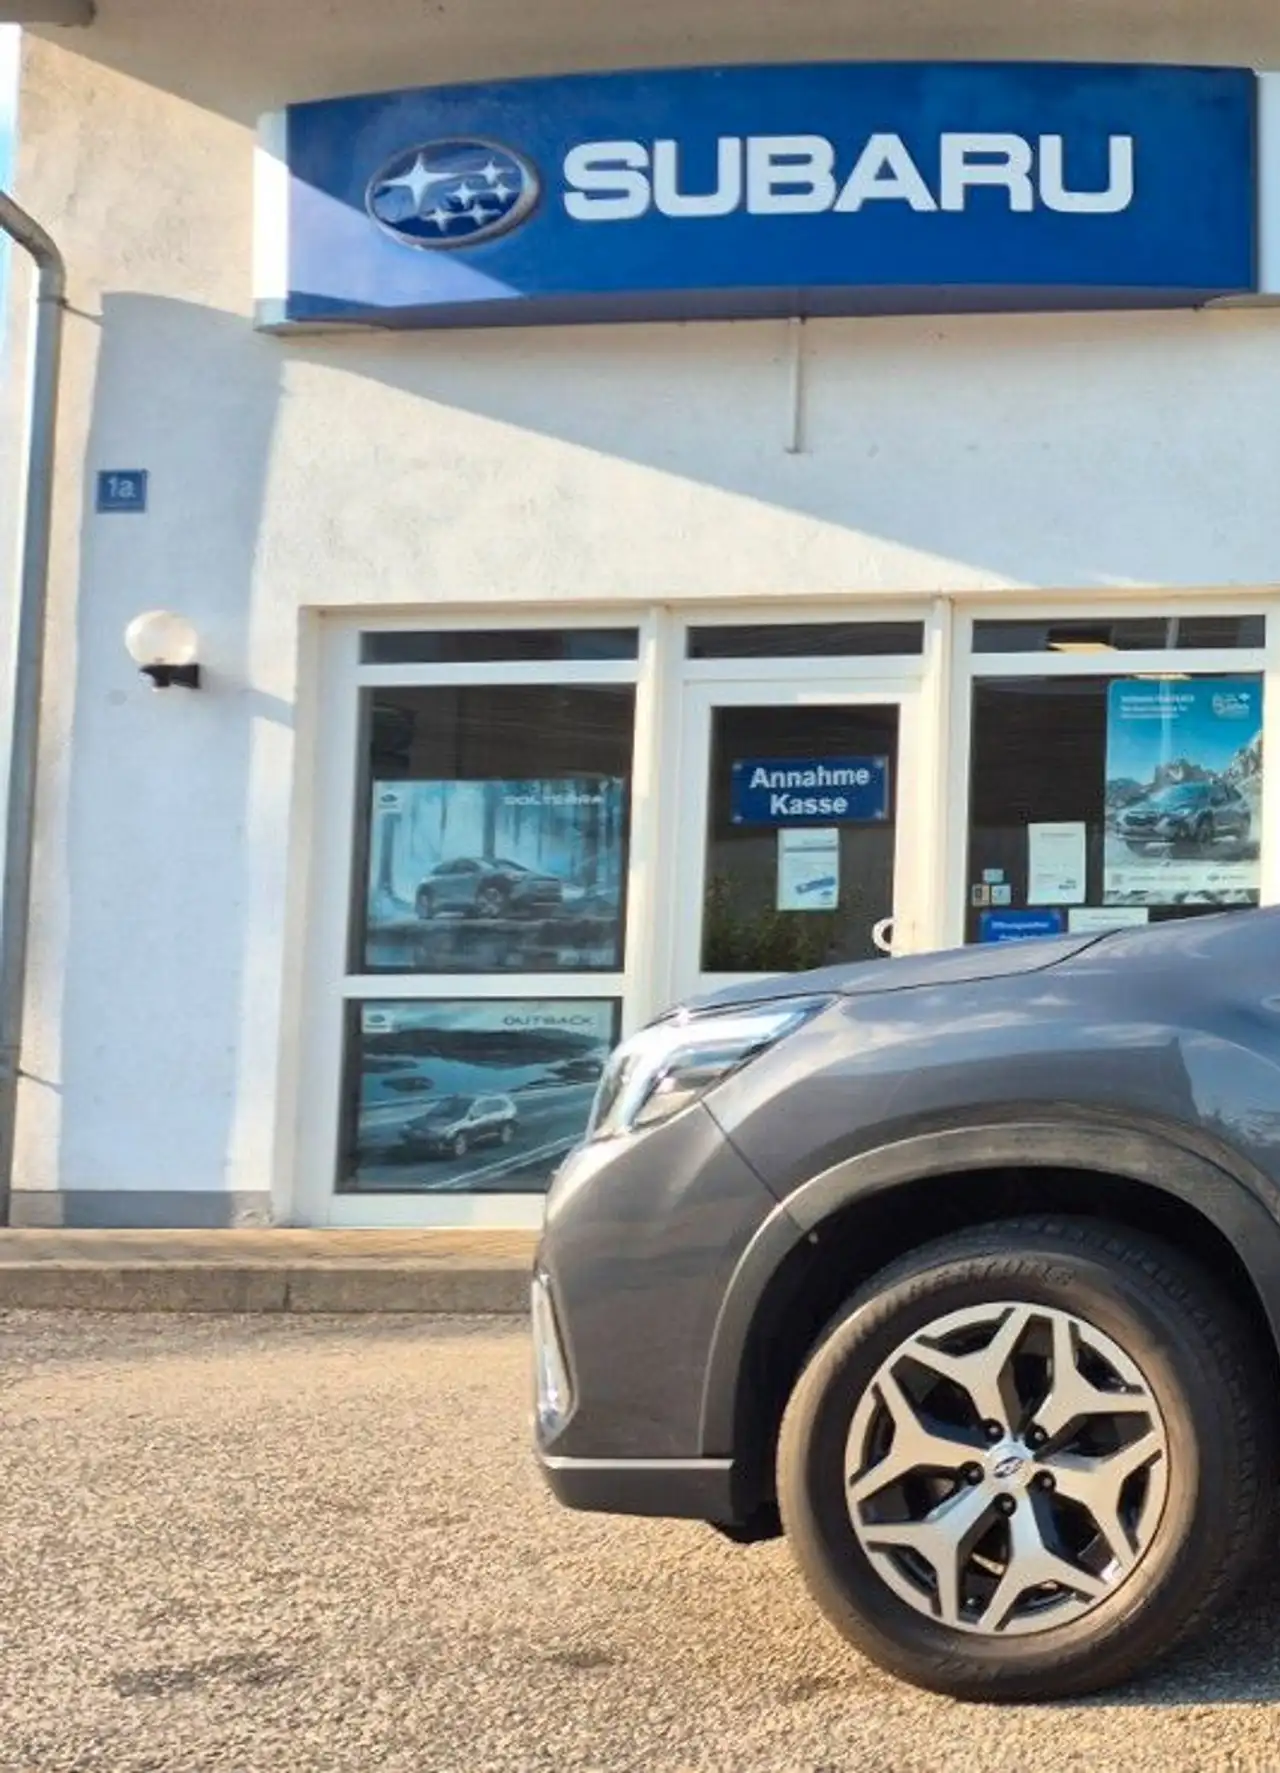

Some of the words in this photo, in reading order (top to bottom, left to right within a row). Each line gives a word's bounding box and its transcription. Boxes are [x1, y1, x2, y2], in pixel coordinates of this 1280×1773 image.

[563, 132, 1134, 222] SUBARU
[107, 476, 137, 499] 1a
[749, 765, 871, 789] Annahme
[770, 793, 849, 816] Kasse
[501, 1014, 596, 1026] OUTBACK
